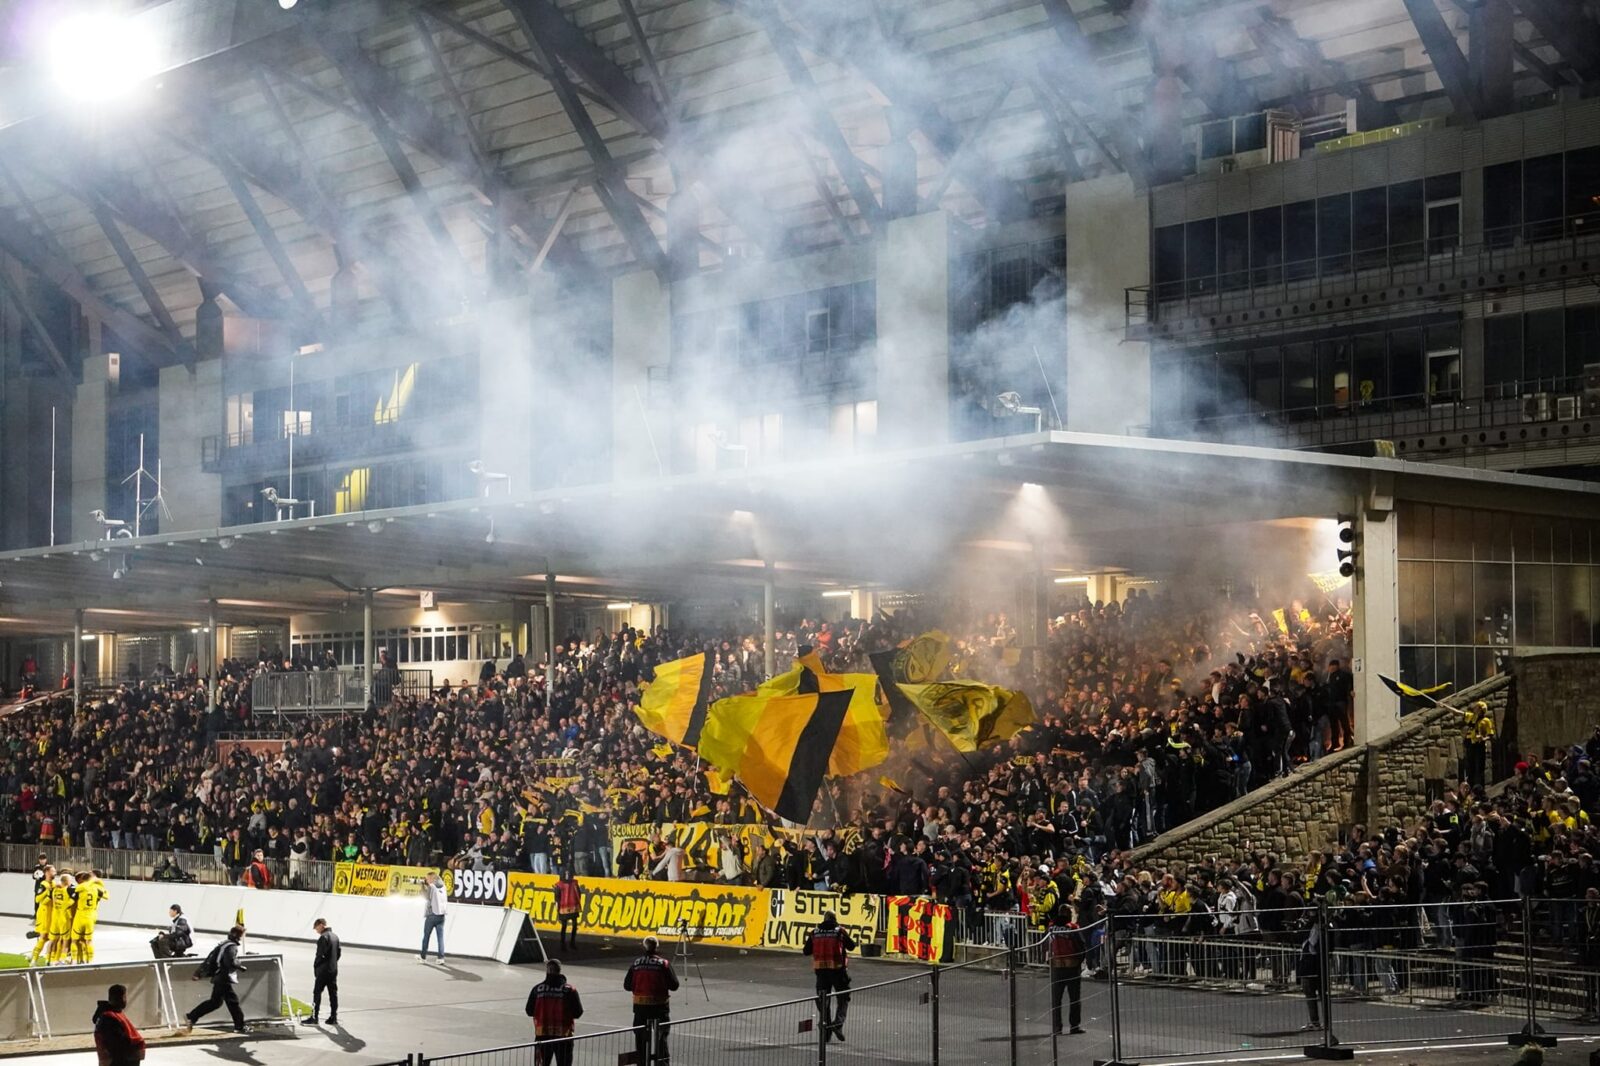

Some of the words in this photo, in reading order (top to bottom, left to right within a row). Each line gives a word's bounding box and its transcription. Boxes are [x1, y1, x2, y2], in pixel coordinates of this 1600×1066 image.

[355, 867, 388, 882] WESTFALEN
[454, 869, 507, 901] 59590
[86, 893, 93, 907] 2
[586, 893, 747, 928] STADIONVERBOT
[795, 892, 851, 916] STETS
[897, 913, 933, 938] 1981
[892, 934, 938, 961] ESSEN
